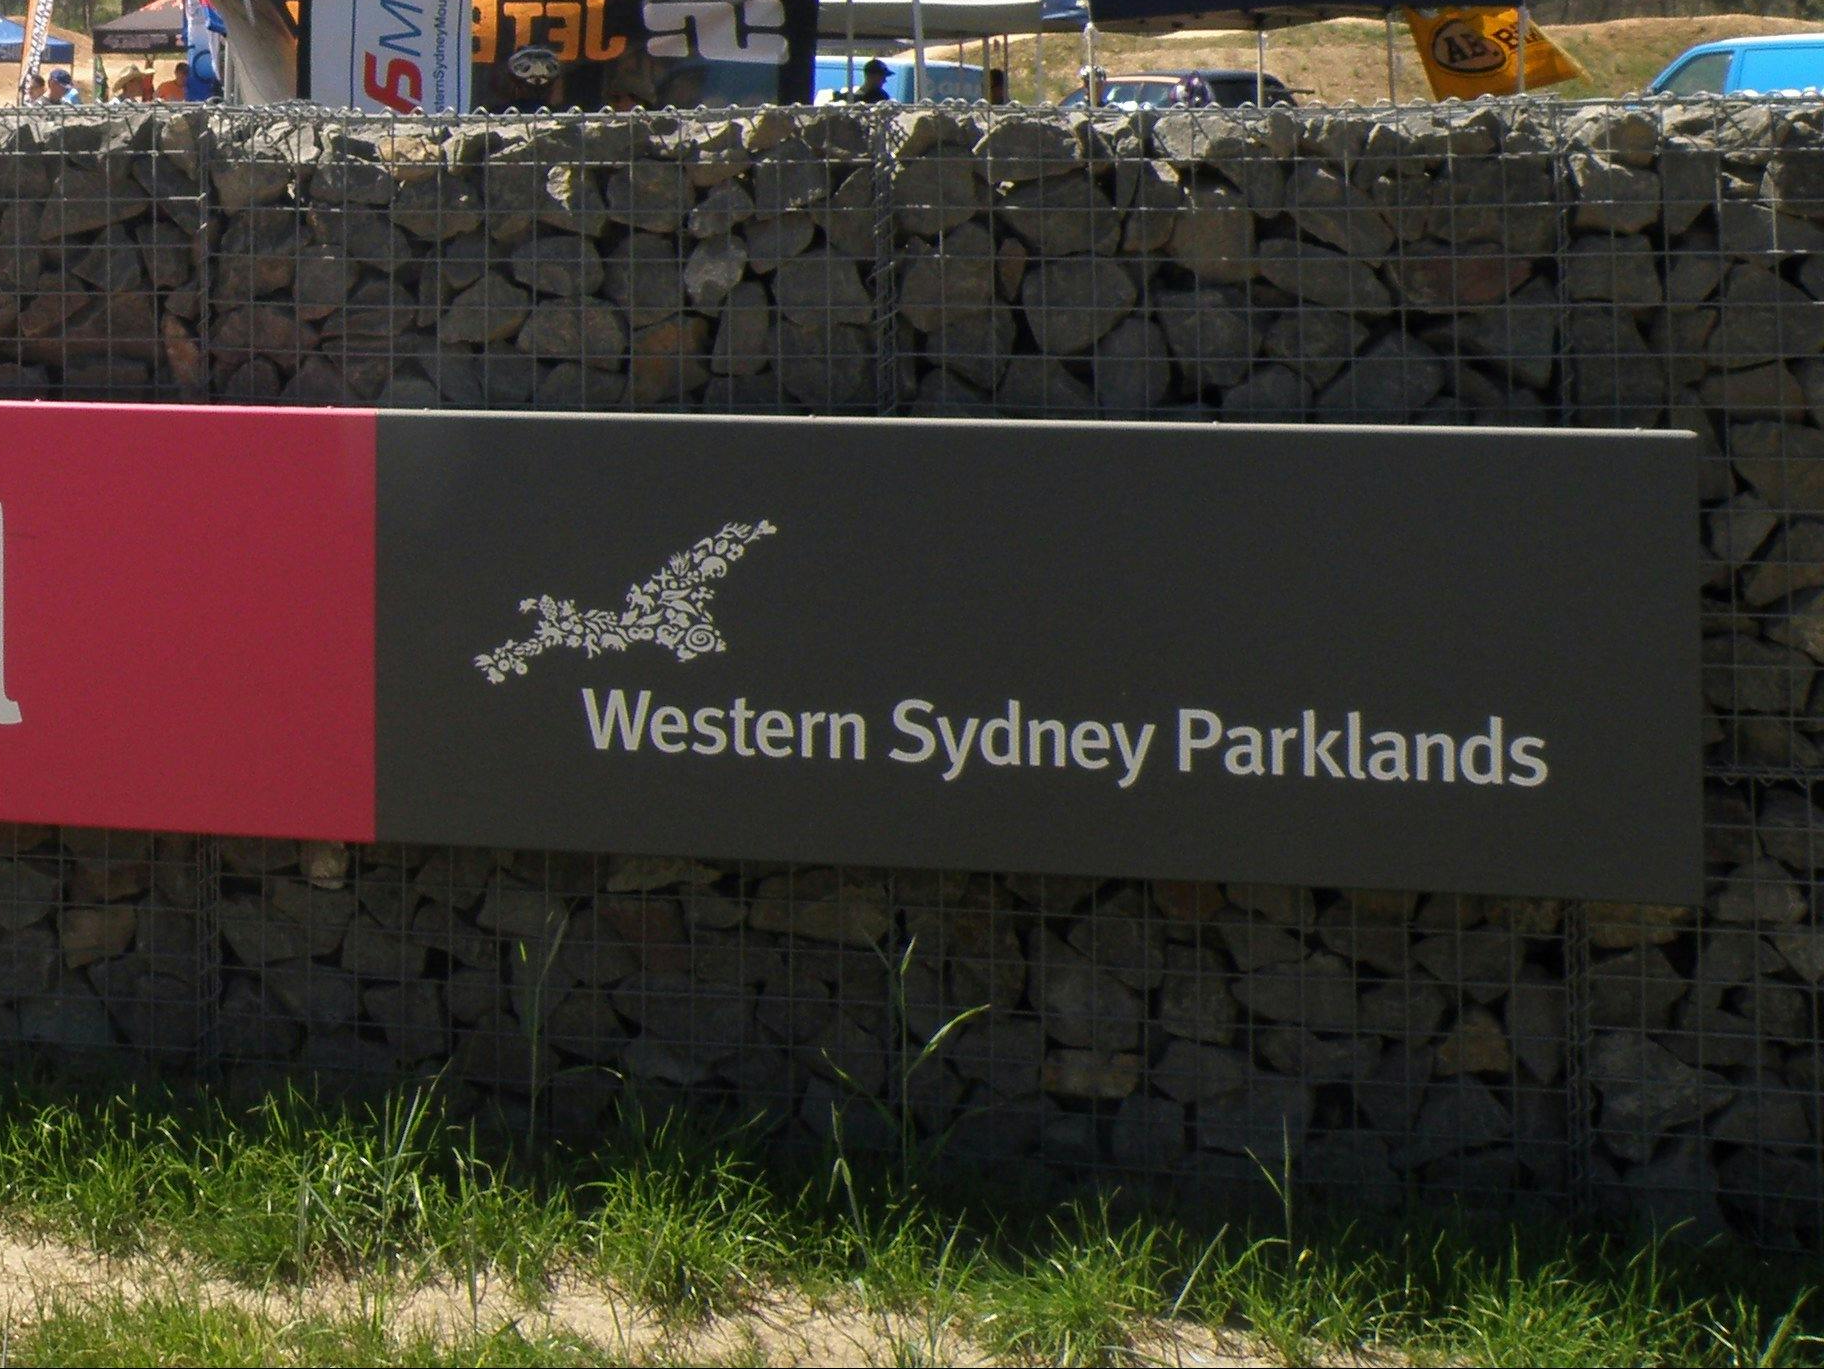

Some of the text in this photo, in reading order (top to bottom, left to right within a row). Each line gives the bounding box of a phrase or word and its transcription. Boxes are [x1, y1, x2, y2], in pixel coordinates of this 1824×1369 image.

[581, 687, 1549, 789] Western Sydney Parklands
